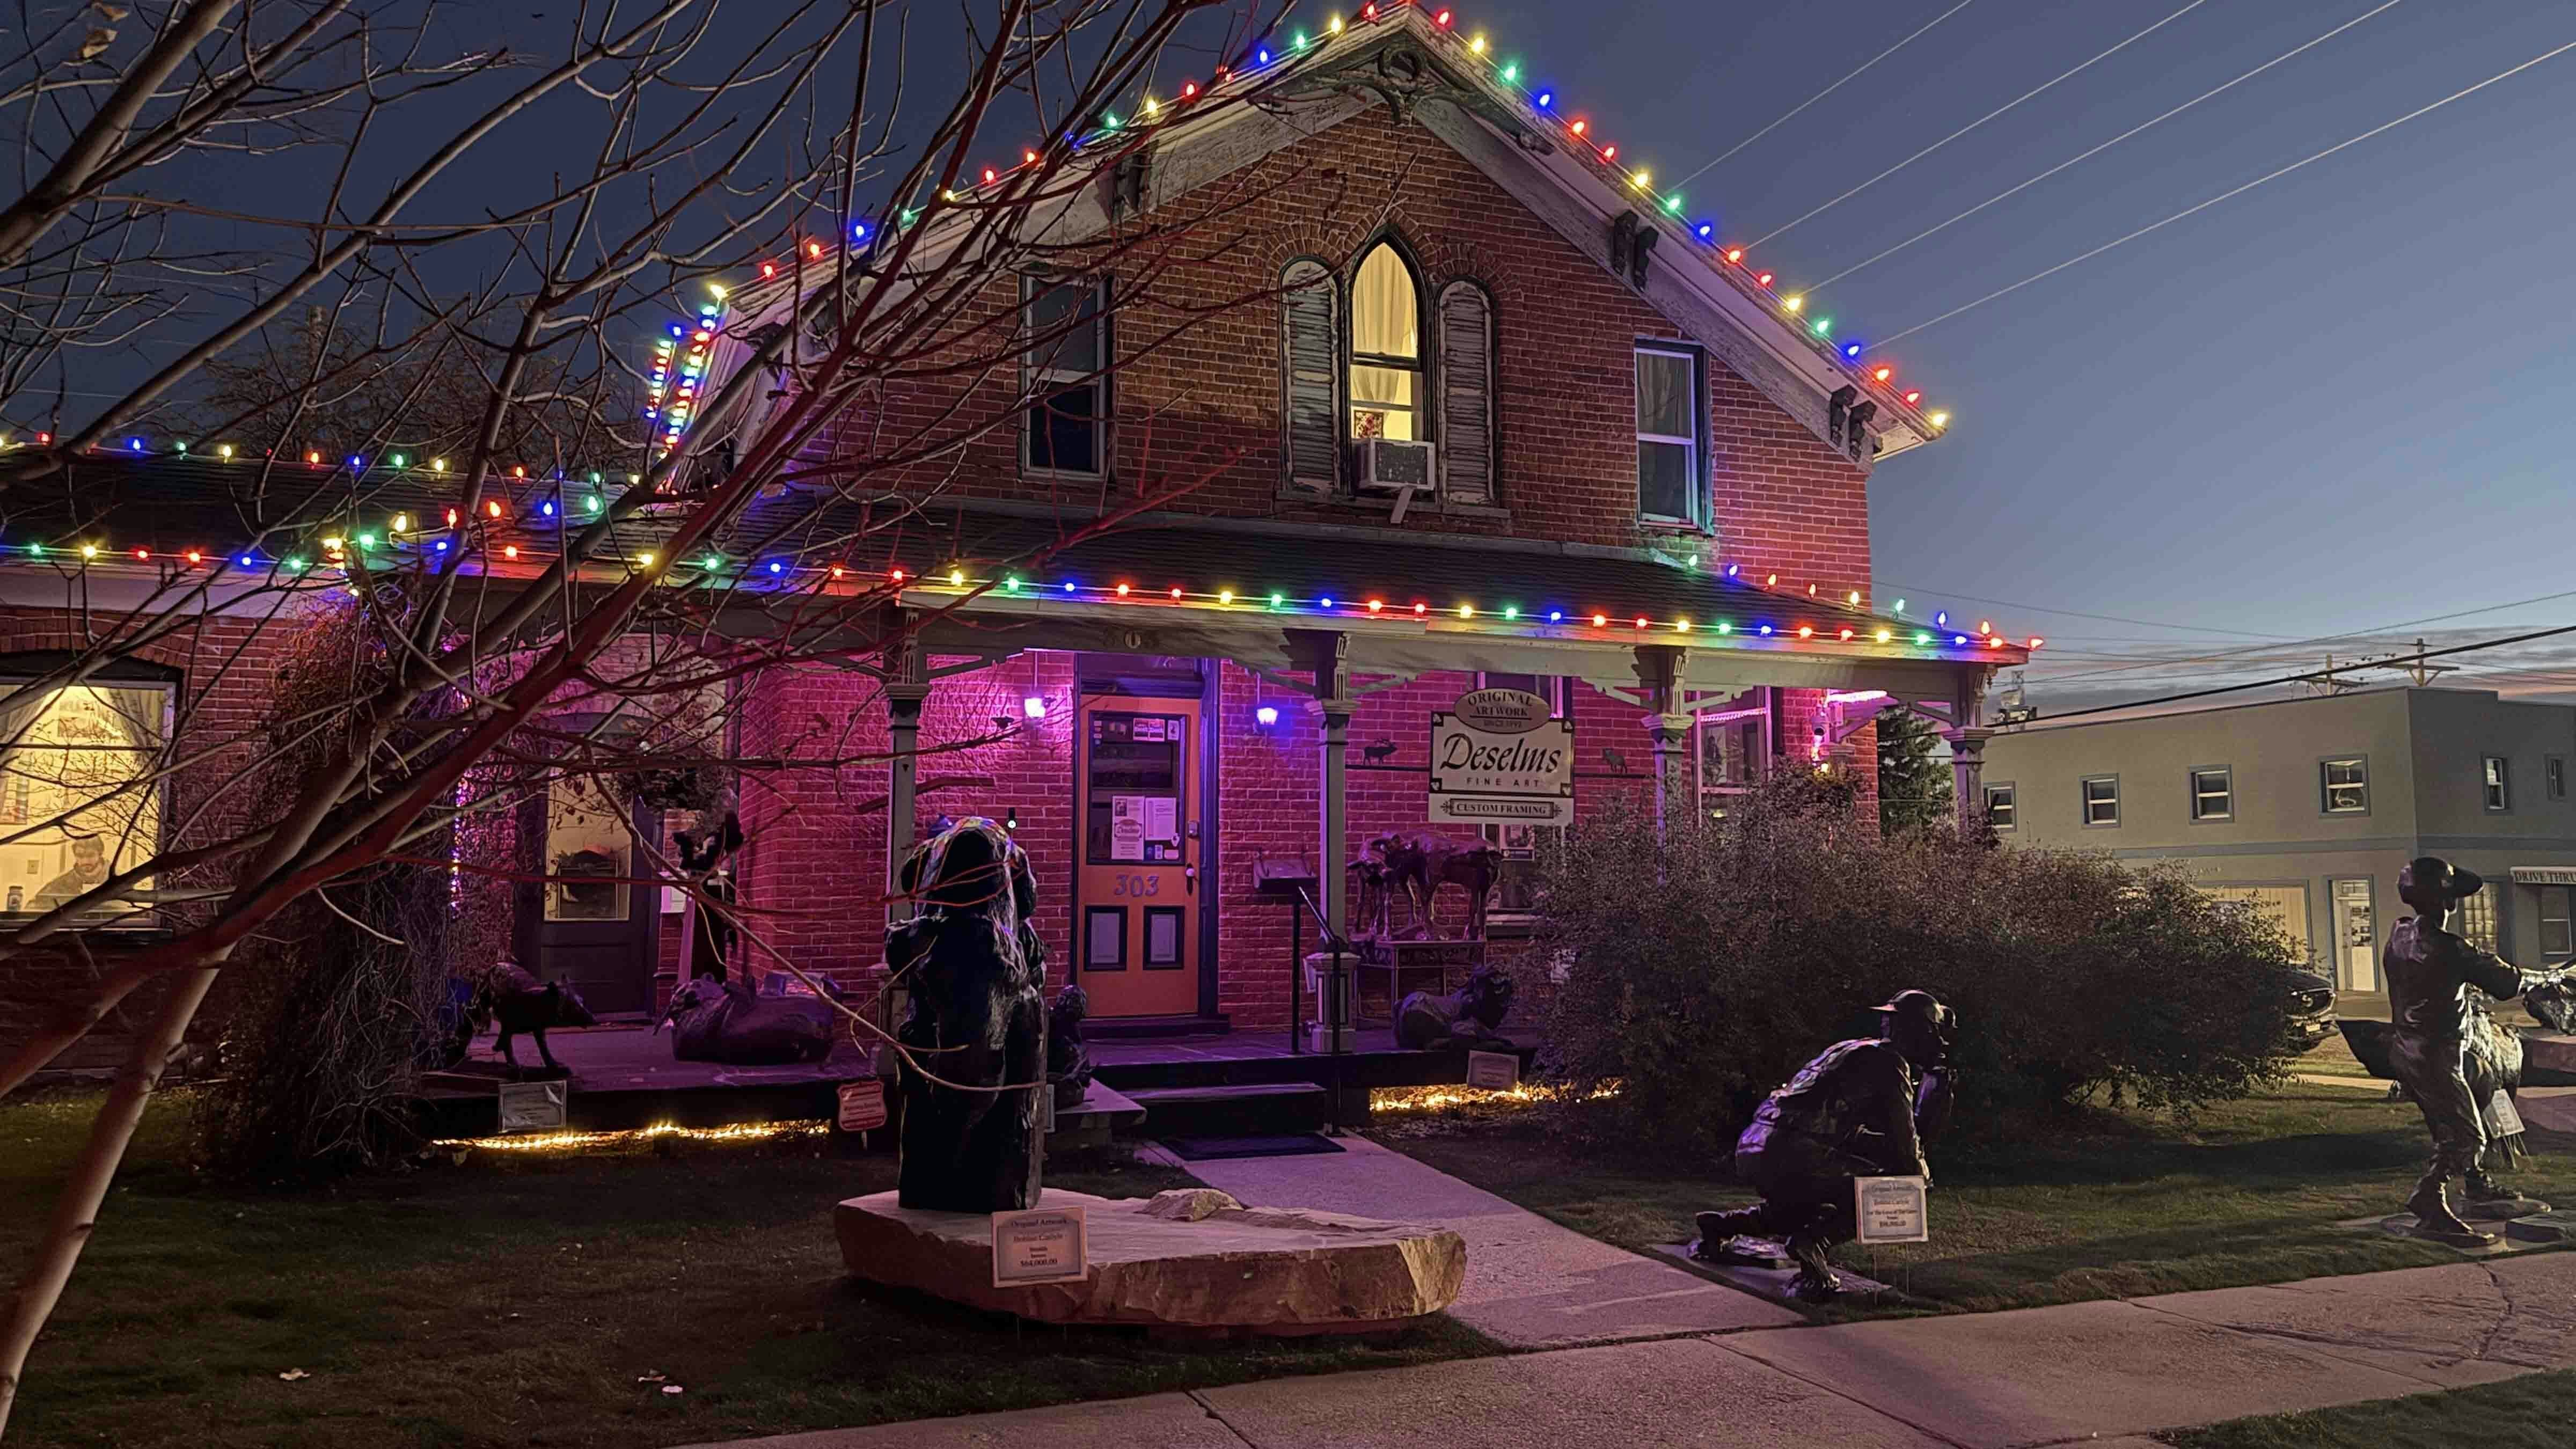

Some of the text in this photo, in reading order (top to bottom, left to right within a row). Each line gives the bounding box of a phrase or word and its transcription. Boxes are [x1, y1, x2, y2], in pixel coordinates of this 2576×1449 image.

[1468, 691, 1533, 706] ORIGINAL
[1476, 706, 1528, 716] ARTWORK
[1440, 733, 1561, 773] Deselms
[1467, 778, 1539, 787] FINE ART
[1457, 803, 1546, 814] CUSTOM FRAMING
[2514, 871, 2547, 882] DRIVE
[1114, 875, 1159, 897] 303
